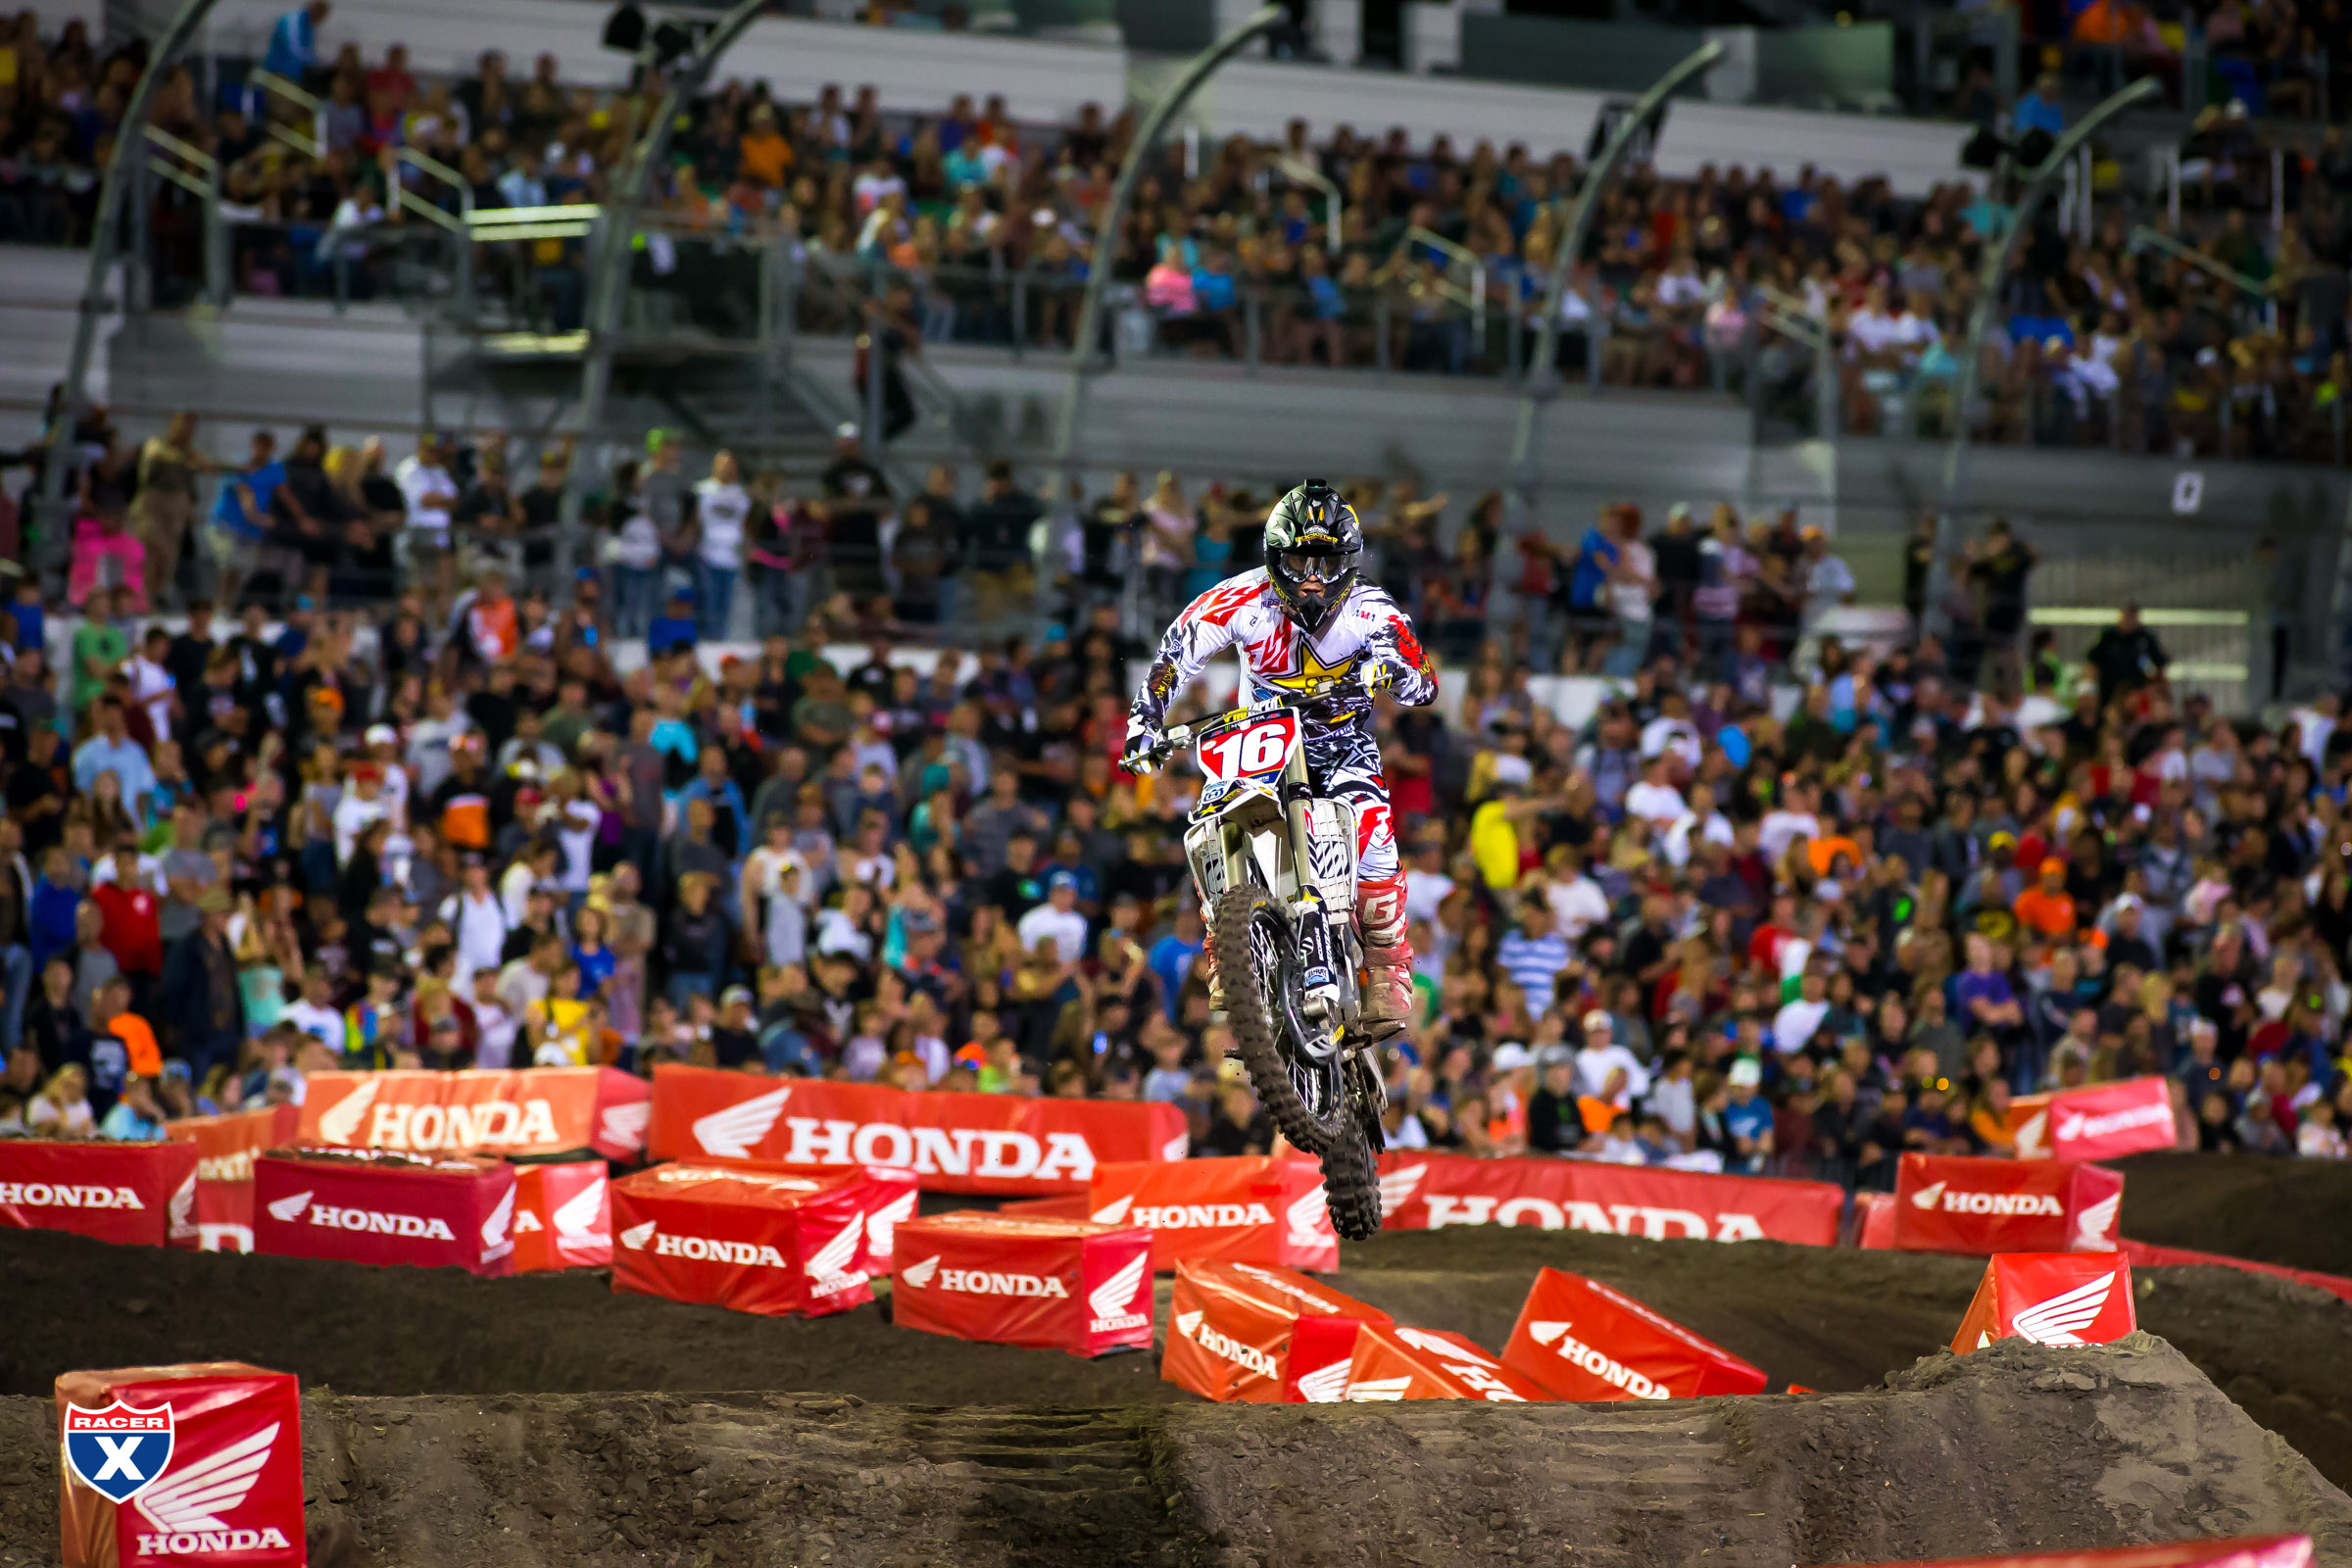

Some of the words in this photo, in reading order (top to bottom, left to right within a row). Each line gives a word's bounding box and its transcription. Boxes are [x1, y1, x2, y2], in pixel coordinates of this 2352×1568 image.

[1212, 723, 1287, 780] 16
[371, 1099, 560, 1150] HONDA
[784, 1117, 1096, 1181] HONDA
[0, 1183, 144, 1209] HONDA
[1944, 1192, 2063, 1215] HONDA
[311, 1204, 455, 1241] HONDA
[1133, 1203, 1274, 1228] HONDA
[656, 1234, 786, 1268] HONDA
[940, 1269, 1068, 1298] HONDA
[1091, 1314, 1148, 1333] HONDA
[1199, 1323, 1279, 1381] HONDA
[1556, 1334, 1670, 1400] HONDA
[137, 1527, 290, 1556] HONDA
